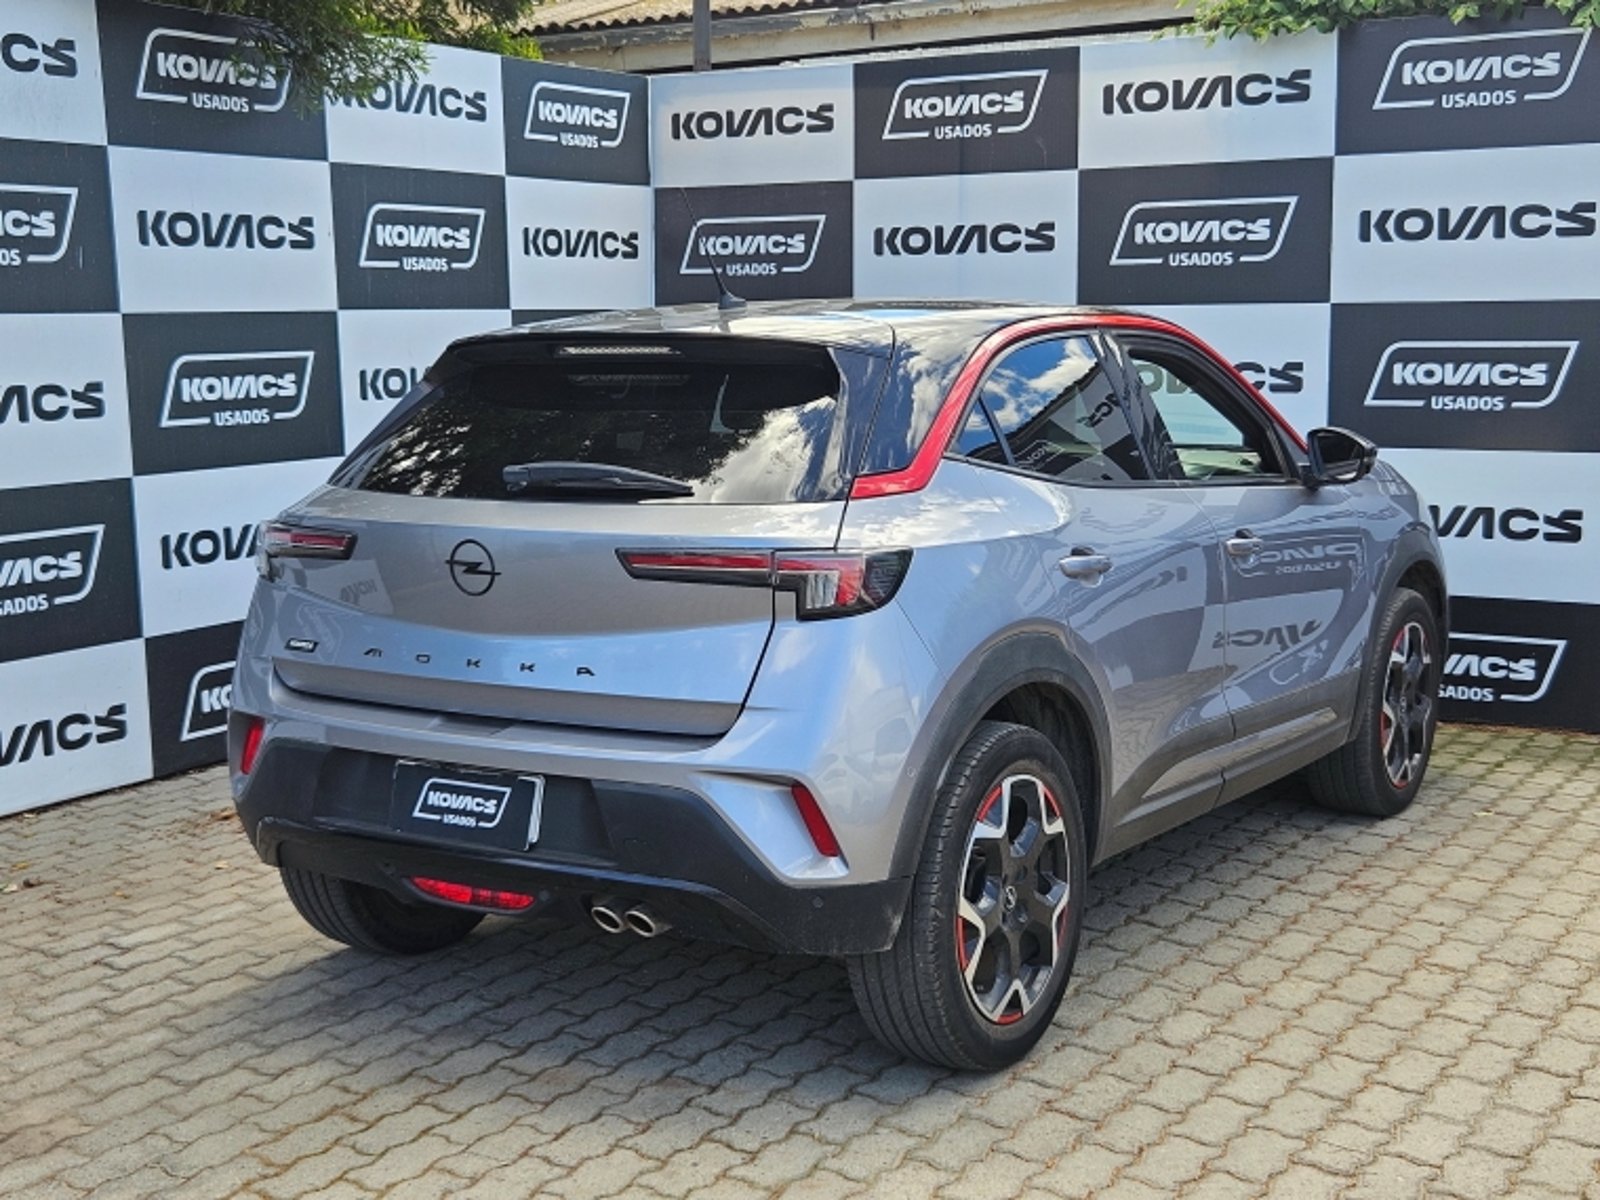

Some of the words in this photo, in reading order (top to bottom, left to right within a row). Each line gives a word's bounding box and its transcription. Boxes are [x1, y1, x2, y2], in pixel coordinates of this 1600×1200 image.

[1402, 52, 1561, 85] KOVACS
[193, 93, 249, 112] USADOS
[1103, 69, 1311, 115] KOVACS
[1442, 90, 1516, 108] USADOS
[539, 101, 617, 128] KOVACS
[904, 90, 1024, 119] KOVACS
[672, 104, 833, 140] KOVACS
[935, 124, 992, 139] USADOS
[560, 133, 598, 148] USADOS
[137, 210, 314, 249] KOVACS
[1135, 218, 1270, 244] KOVACS
[1359, 202, 1596, 242] KOVACS
[376, 225, 470, 248] KOVACS
[523, 227, 638, 259] KOVACS
[698, 234, 805, 256] KOVACS
[874, 222, 1055, 256] KOVACS
[403, 257, 448, 271] USADOS
[726, 263, 777, 277] USADOS
[1169, 252, 1233, 266] USADOS
[1393, 363, 1547, 385] KOVACS
[181, 373, 297, 402] KOVACS
[1431, 396, 1504, 410] USADOS
[214, 409, 270, 426] USADOS
[427, 791, 498, 814] KOVACS
